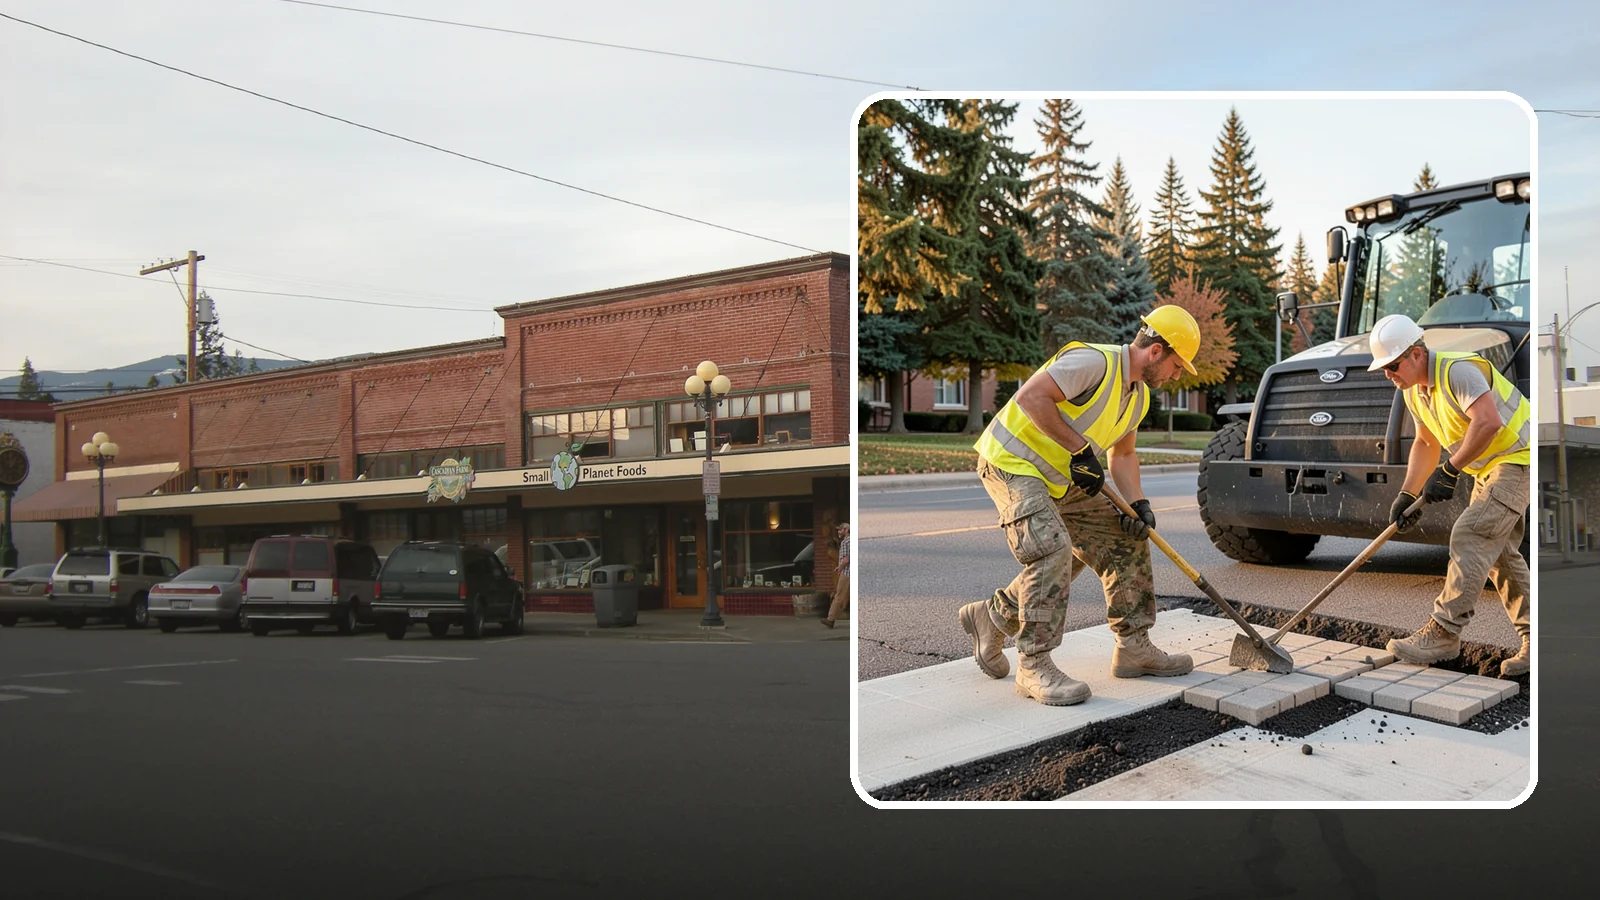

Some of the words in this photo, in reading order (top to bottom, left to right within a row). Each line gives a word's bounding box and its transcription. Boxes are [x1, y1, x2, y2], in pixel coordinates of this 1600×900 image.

[523, 471, 549, 483] Small
[582, 465, 614, 479] Planet
[616, 464, 647, 477] Foods
